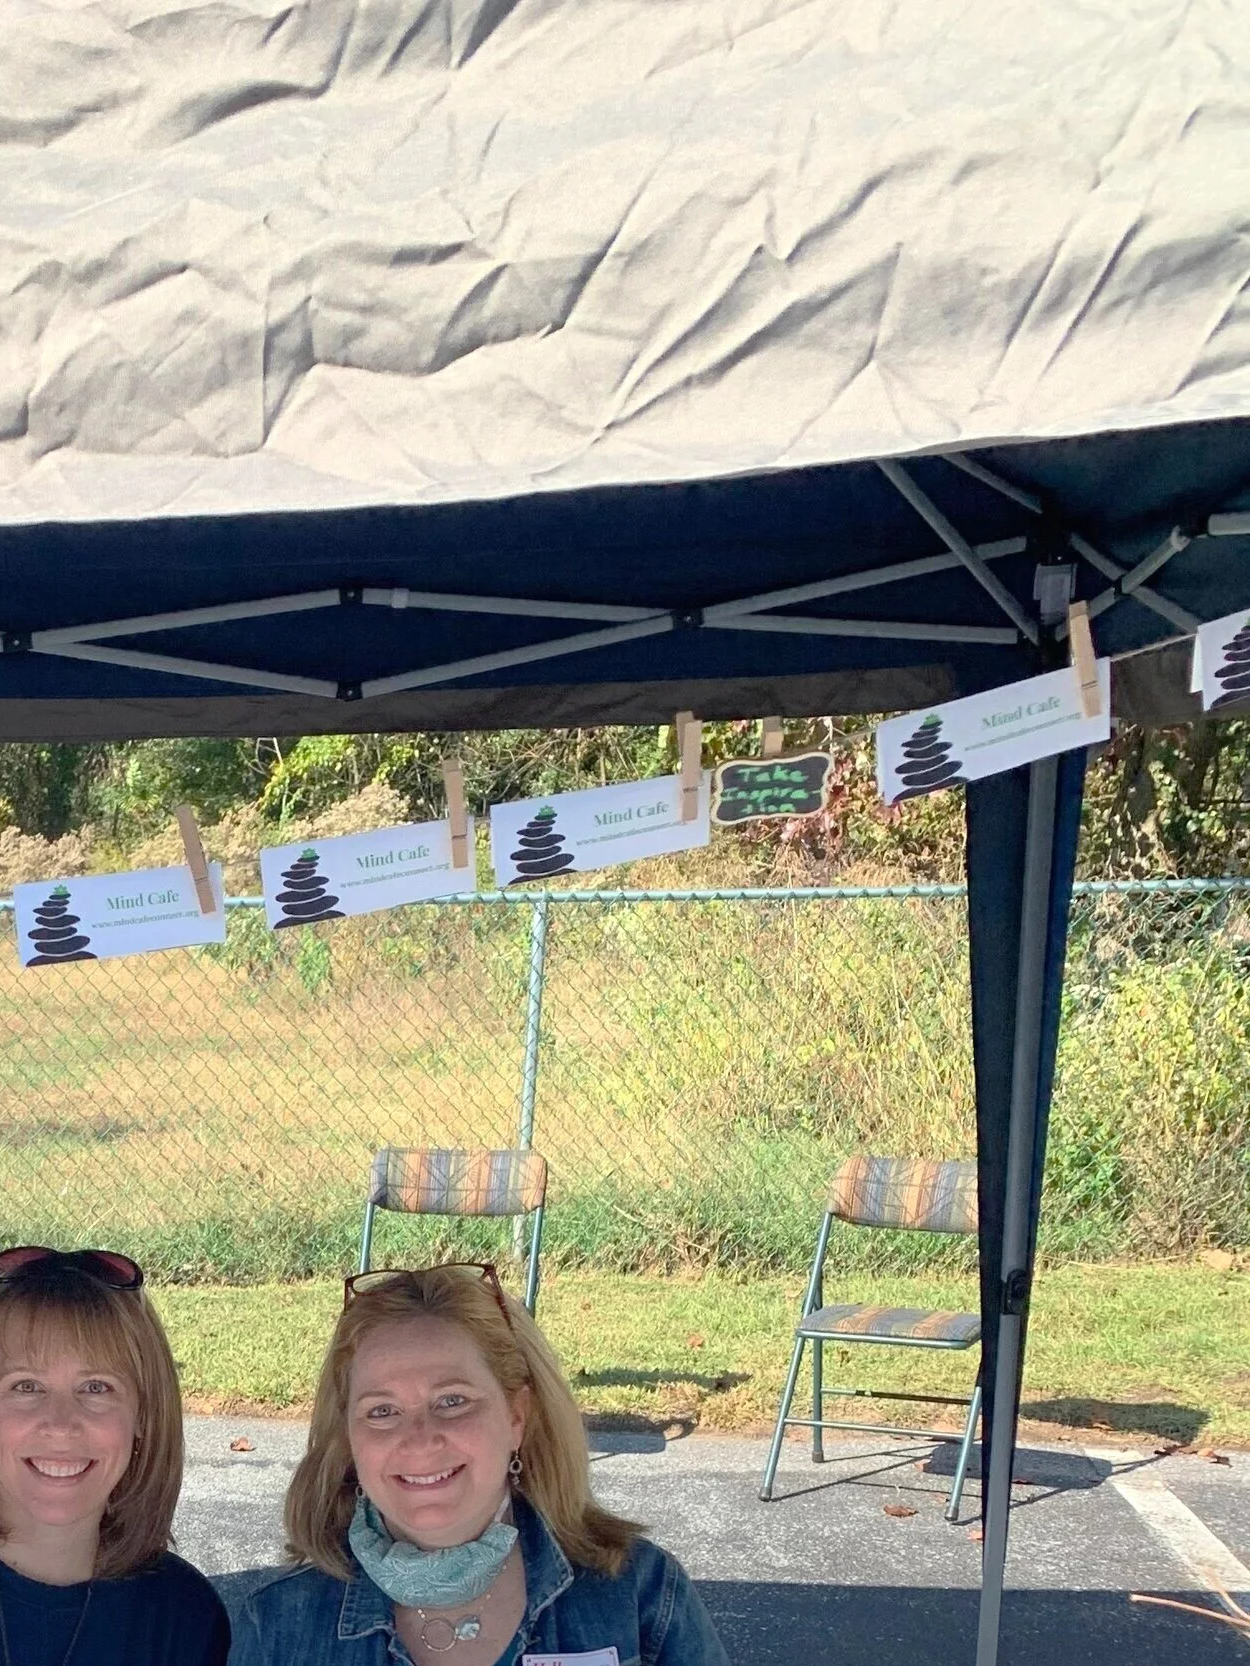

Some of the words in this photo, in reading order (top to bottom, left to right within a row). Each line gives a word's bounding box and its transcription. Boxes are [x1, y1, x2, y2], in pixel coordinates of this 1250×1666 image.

[982, 706, 1023, 728] Mind
[1026, 696, 1060, 716] Cafe
[594, 808, 632, 826] Mind
[636, 801, 669, 819] Cafe
[356, 851, 393, 869] Mind
[397, 845, 430, 862] Cafe
[106, 893, 143, 911] Mind
[147, 890, 179, 906] Cafe
